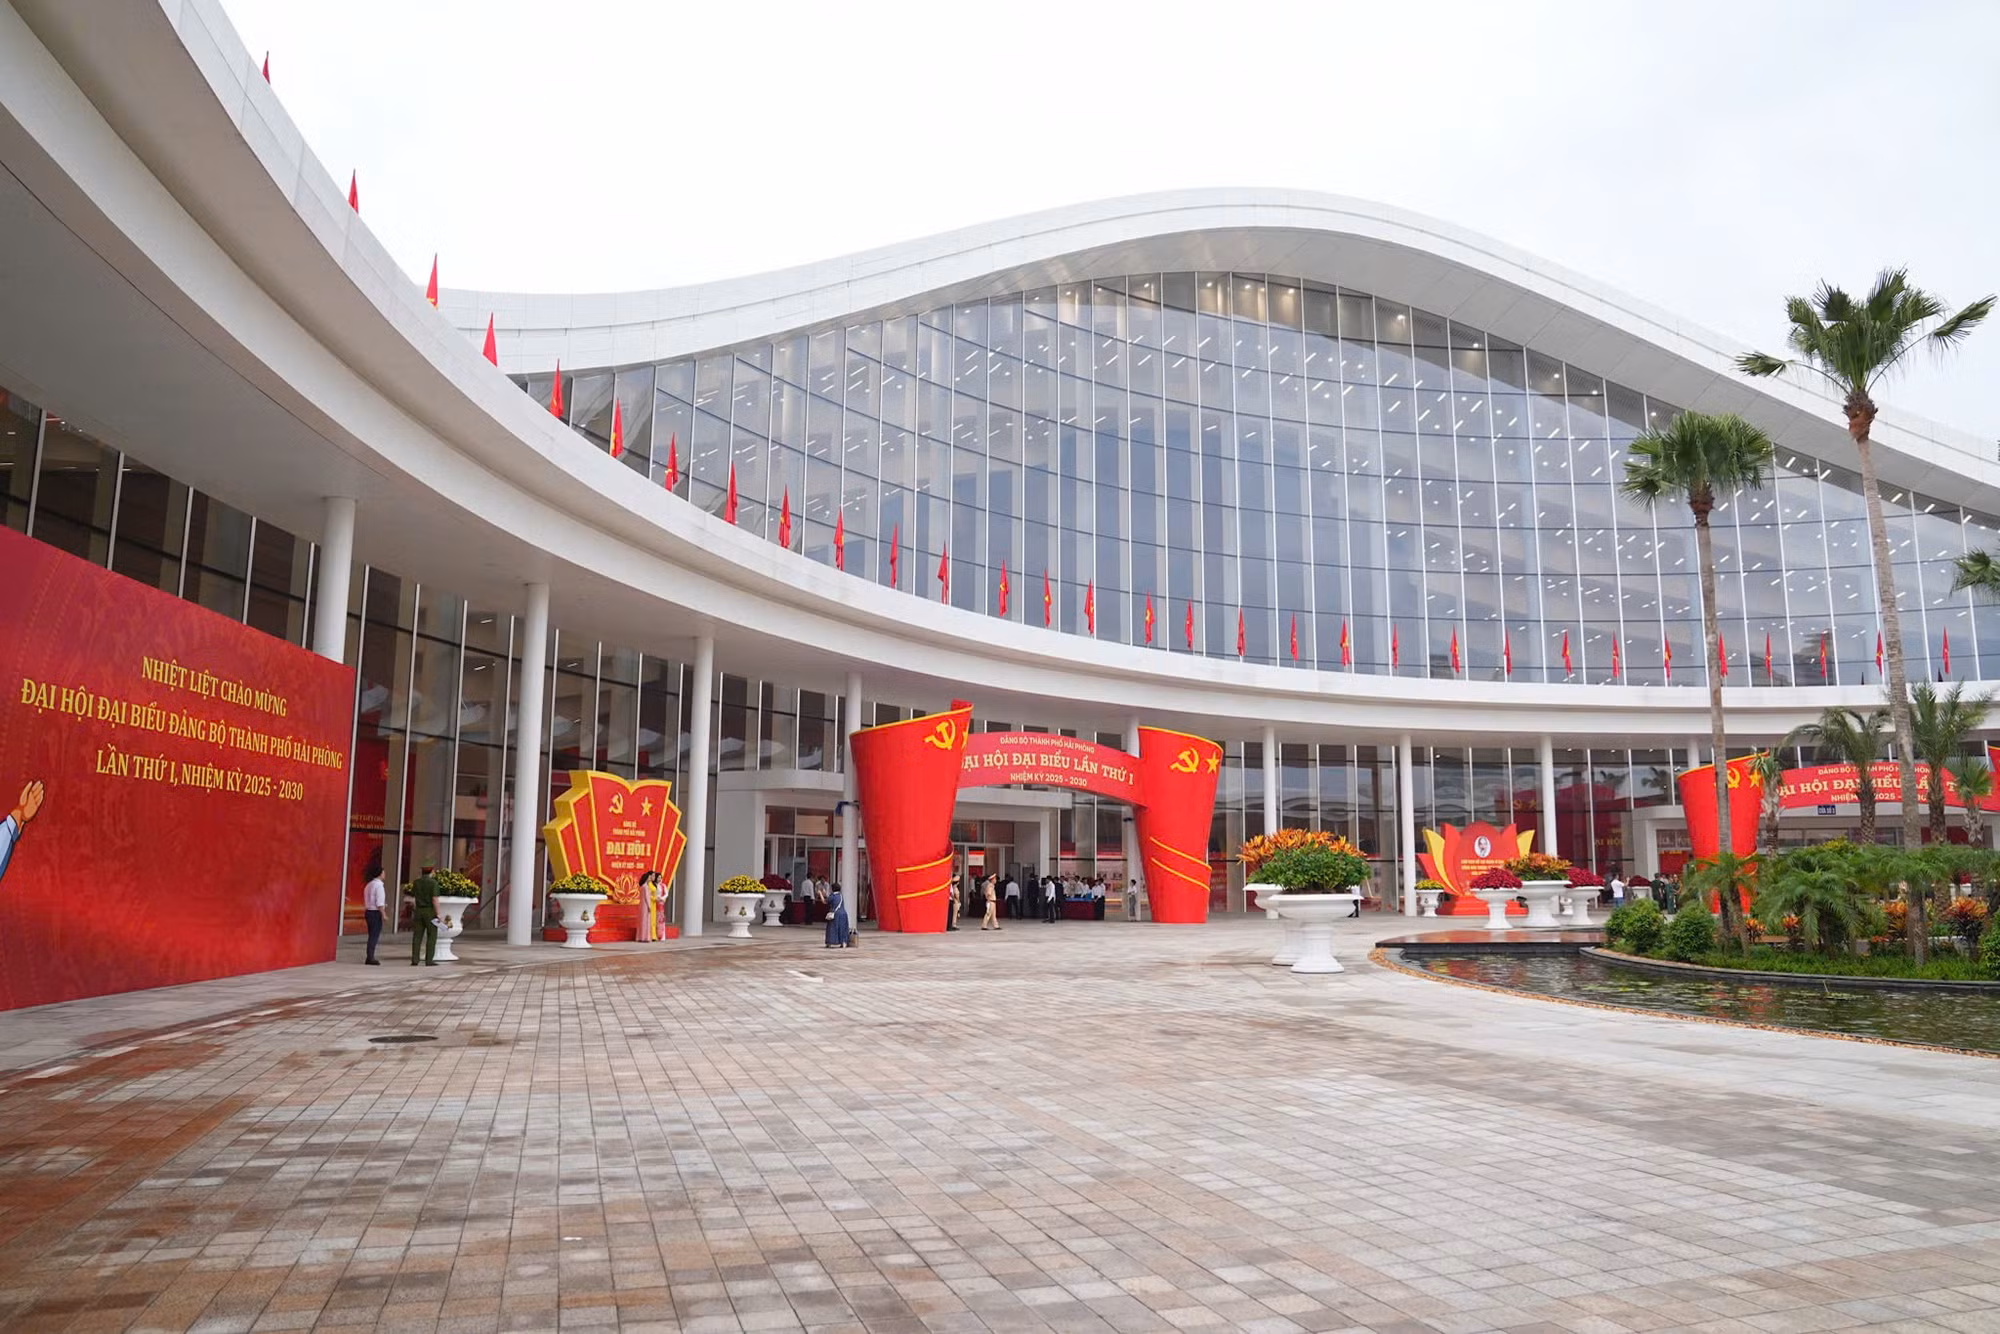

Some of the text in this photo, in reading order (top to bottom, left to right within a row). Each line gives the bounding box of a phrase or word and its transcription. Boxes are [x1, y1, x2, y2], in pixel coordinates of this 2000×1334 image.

[142, 656, 287, 717] NHIỆT LIỆT CHÀO MỪNG
[20, 678, 343, 769] ĐẠI HỘI ĐẠI BIỂU ĐẢNG BỘ THÀNH PHỐ HẢI PHÒNG
[96, 743, 129, 776] LẦN
[133, 753, 167, 781] THỨ
[169, 761, 178, 787] I,
[181, 763, 224, 793] NHIỆM
[226, 767, 243, 792] KỲ
[244, 774, 271, 796] 2025
[278, 780, 304, 801] 2030
[961, 754, 979, 773] ẠI
[983, 749, 1009, 769] HỘI
[1012, 752, 1036, 769] ĐẠI
[1040, 749, 1070, 768] BIỂU
[1101, 764, 1126, 782] THỨ
[1010, 770, 1033, 783] NHIỆM
[1045, 773, 1063, 783] 2025
[1069, 776, 1088, 786] 2030
[1800, 778, 1828, 794] HỘI
[606, 840, 651, 859] ĐẠI HỘI I
